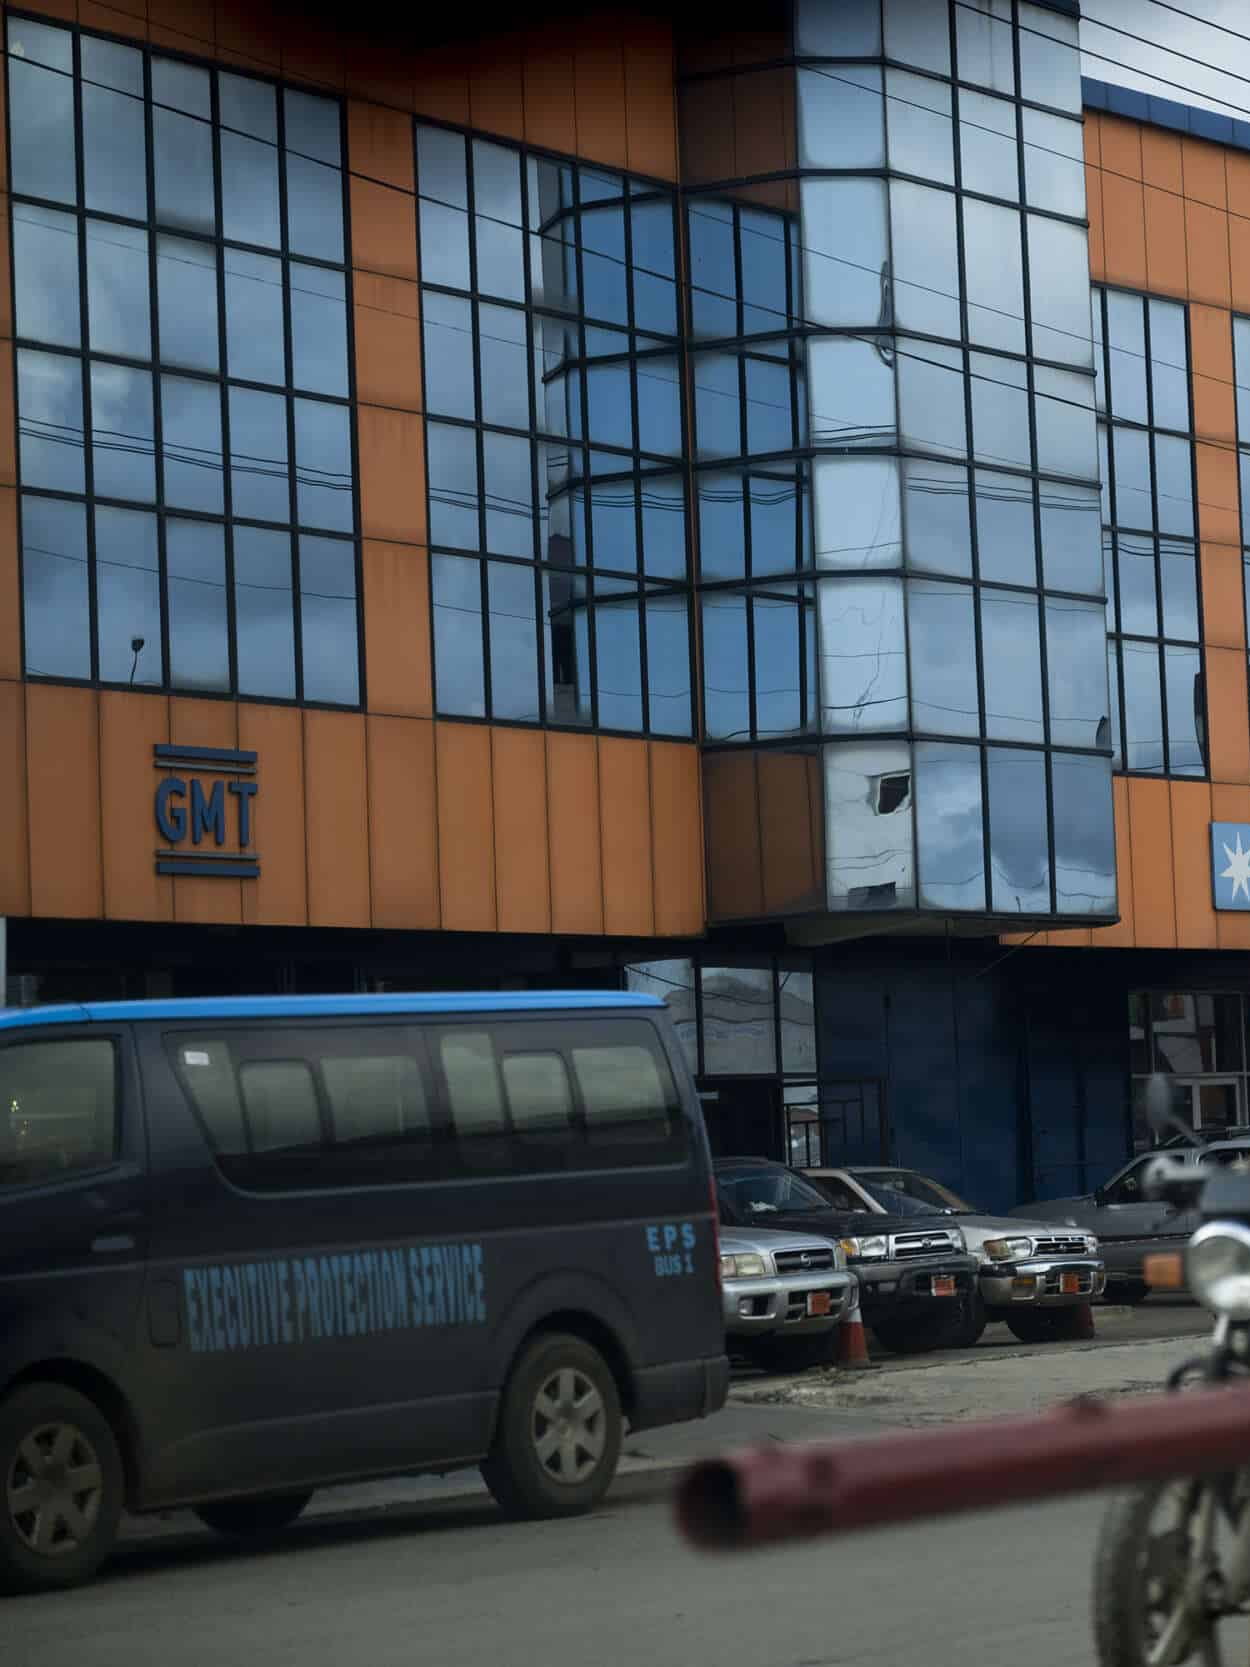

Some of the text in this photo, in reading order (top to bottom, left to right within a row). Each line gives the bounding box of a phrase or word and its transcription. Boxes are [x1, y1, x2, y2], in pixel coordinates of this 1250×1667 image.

[155, 777, 258, 847] GMT
[183, 1244, 486, 1352] EXECUTIVE PROTECTION SERVICE
[655, 1255, 681, 1276] BUS
